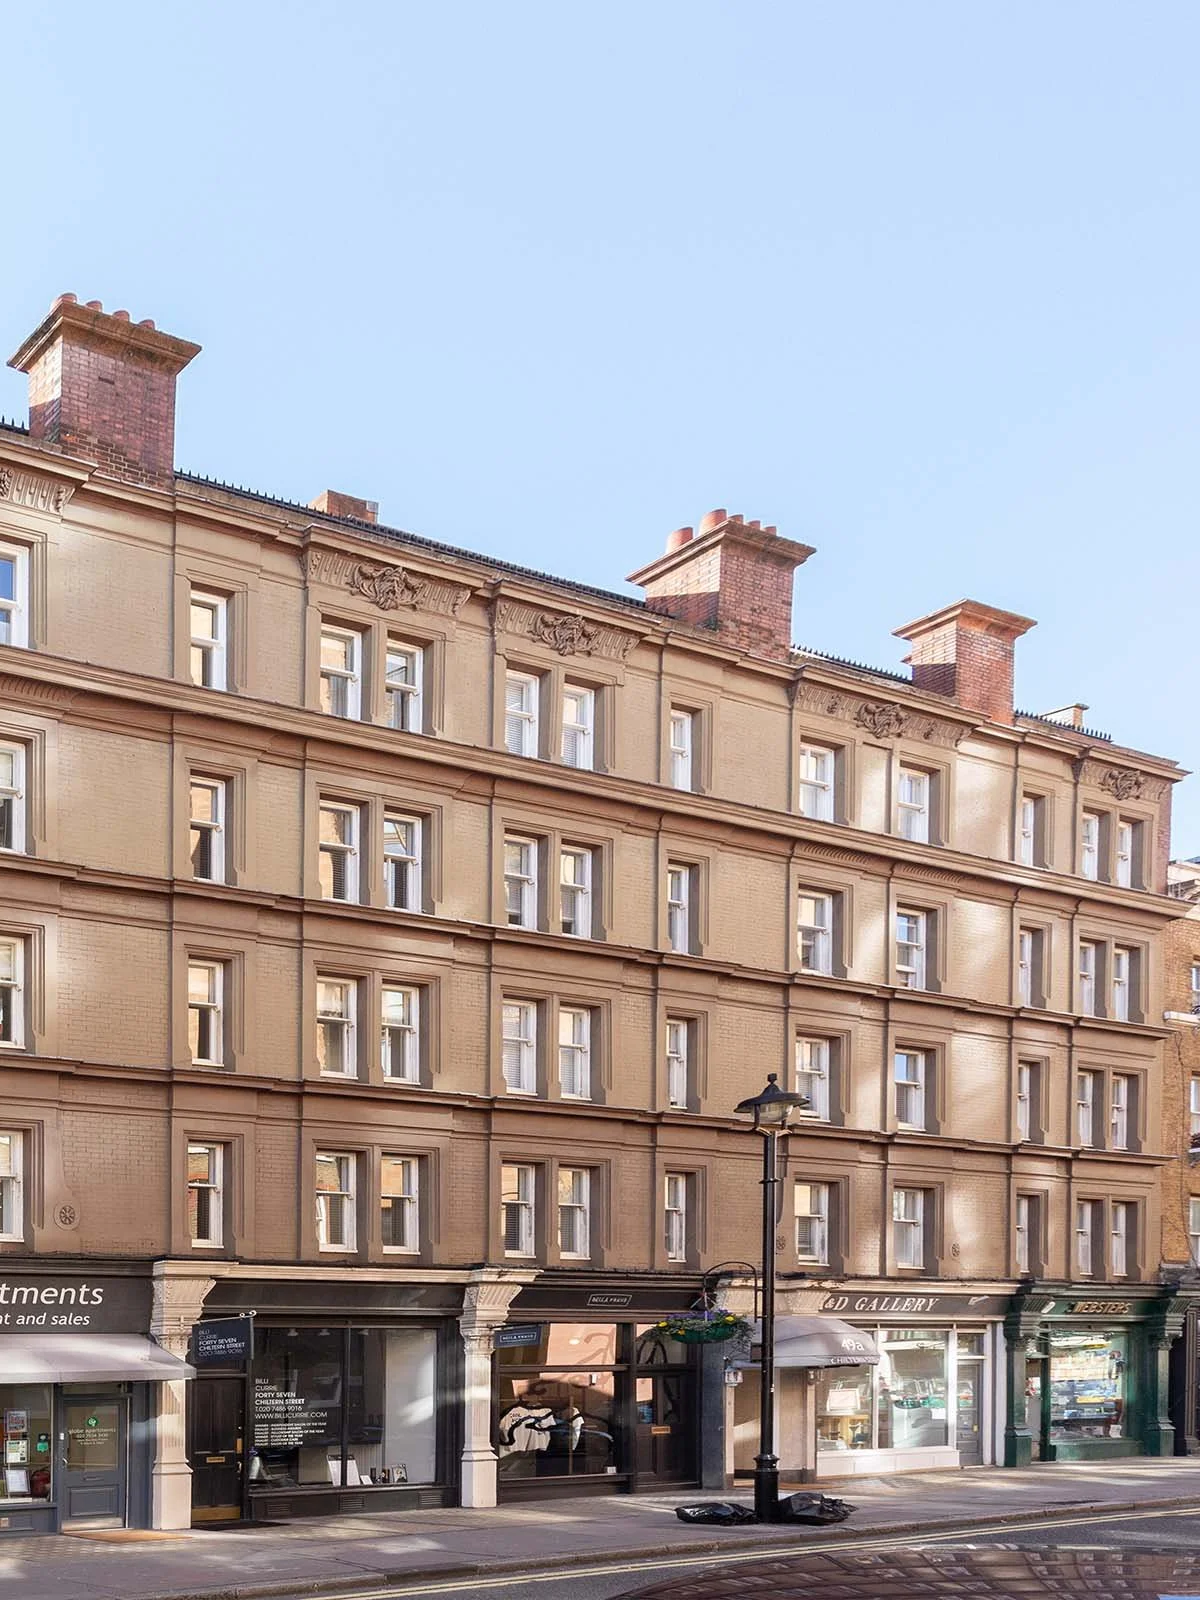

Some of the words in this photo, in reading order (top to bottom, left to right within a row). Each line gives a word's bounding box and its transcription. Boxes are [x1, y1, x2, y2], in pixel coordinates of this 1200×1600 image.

[855, 1297, 940, 1312] GALLERY
[1072, 1301, 1133, 1314] WEBSTERS
[15, 1312, 47, 1325] and
[50, 1312, 91, 1325] sales
[841, 1338, 865, 1351] 49a
